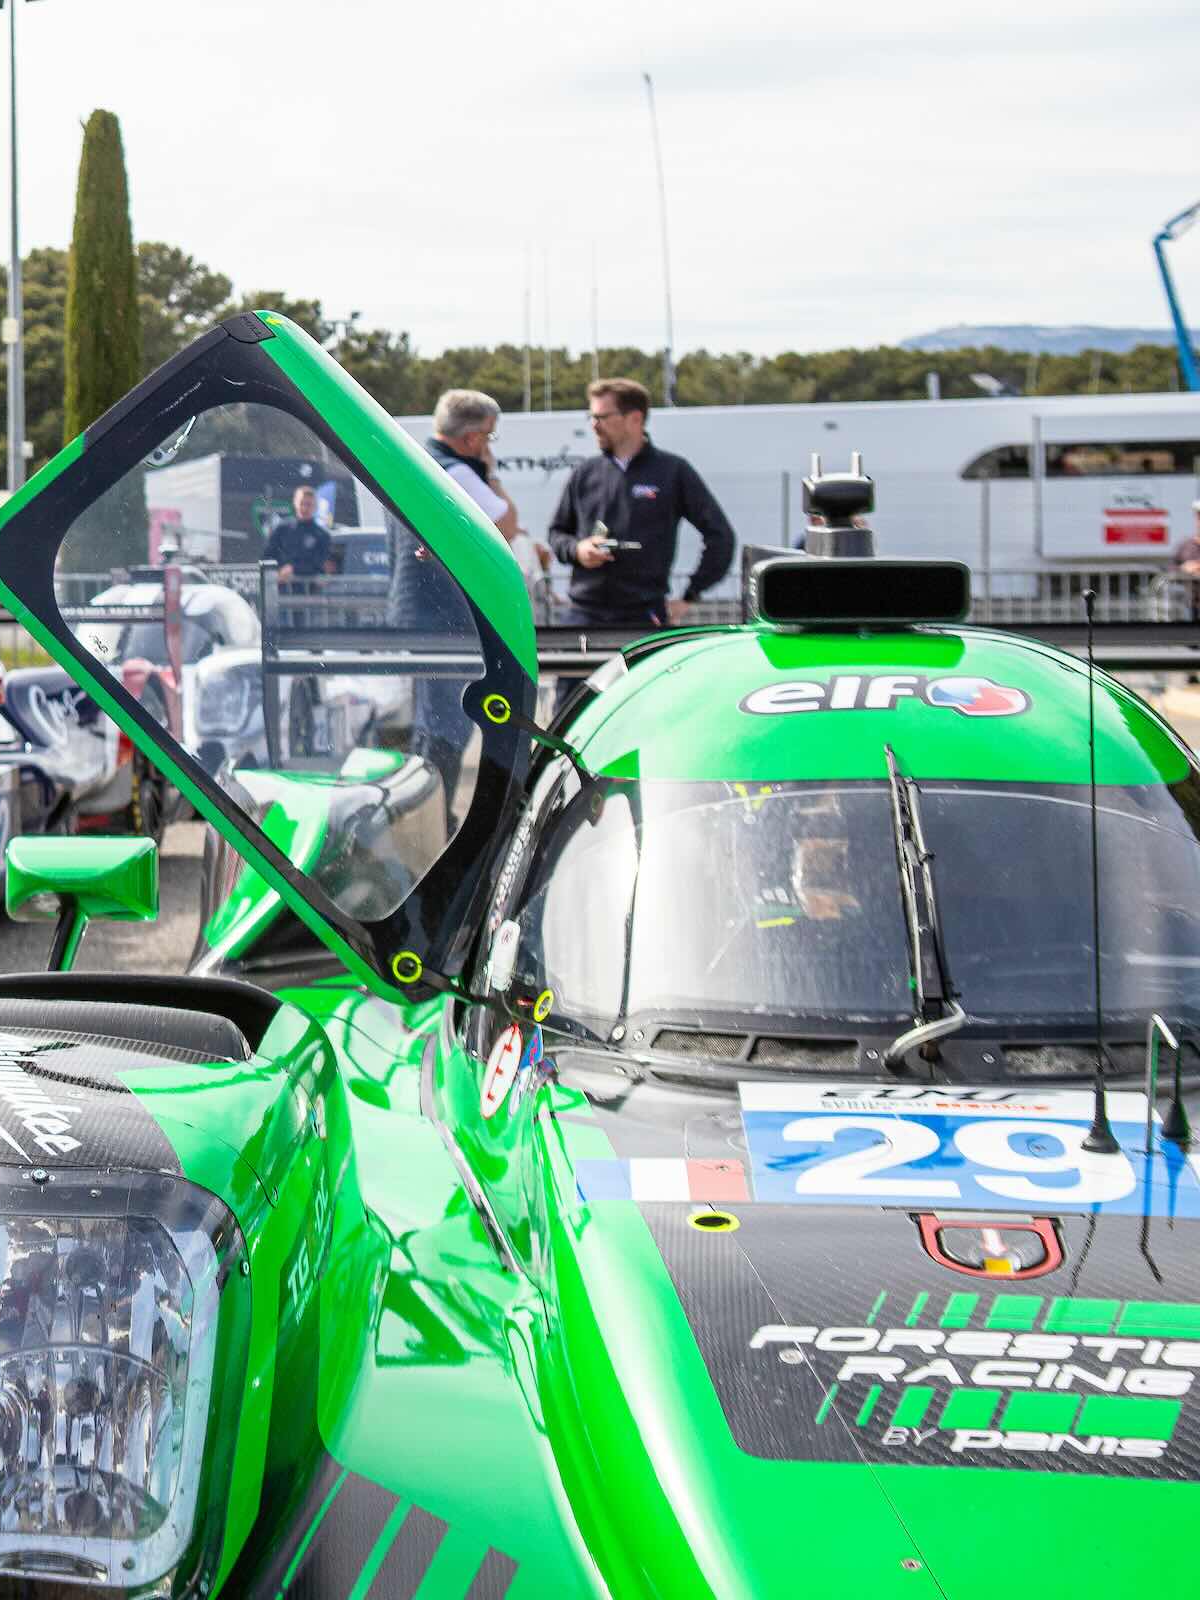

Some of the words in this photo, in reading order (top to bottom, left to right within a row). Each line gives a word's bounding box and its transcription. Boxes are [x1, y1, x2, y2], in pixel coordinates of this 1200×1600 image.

[742, 675, 920, 714] elf
[783, 1116, 1136, 1203] 29
[749, 1325, 1200, 1366] FORESTIE
[837, 1355, 1196, 1396] RACING
[881, 1426, 938, 1447] BY
